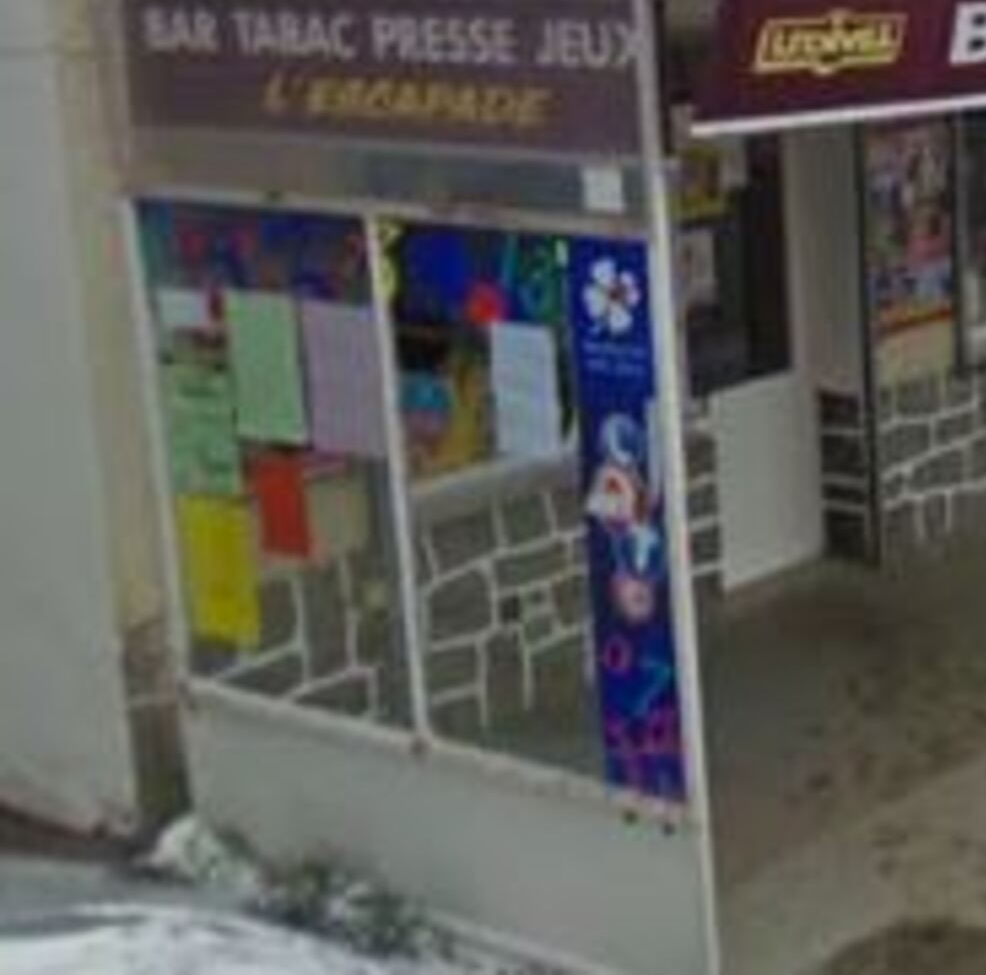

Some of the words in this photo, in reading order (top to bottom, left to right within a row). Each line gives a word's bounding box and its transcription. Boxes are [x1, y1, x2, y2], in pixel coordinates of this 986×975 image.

[141, 6, 219, 54] BAR
[229, 9, 356, 60] TABAC
[370, 14, 521, 63] PRESSE
[535, 19, 640, 69] JEUX
[260, 71, 556, 128] L'ESCAPADE
